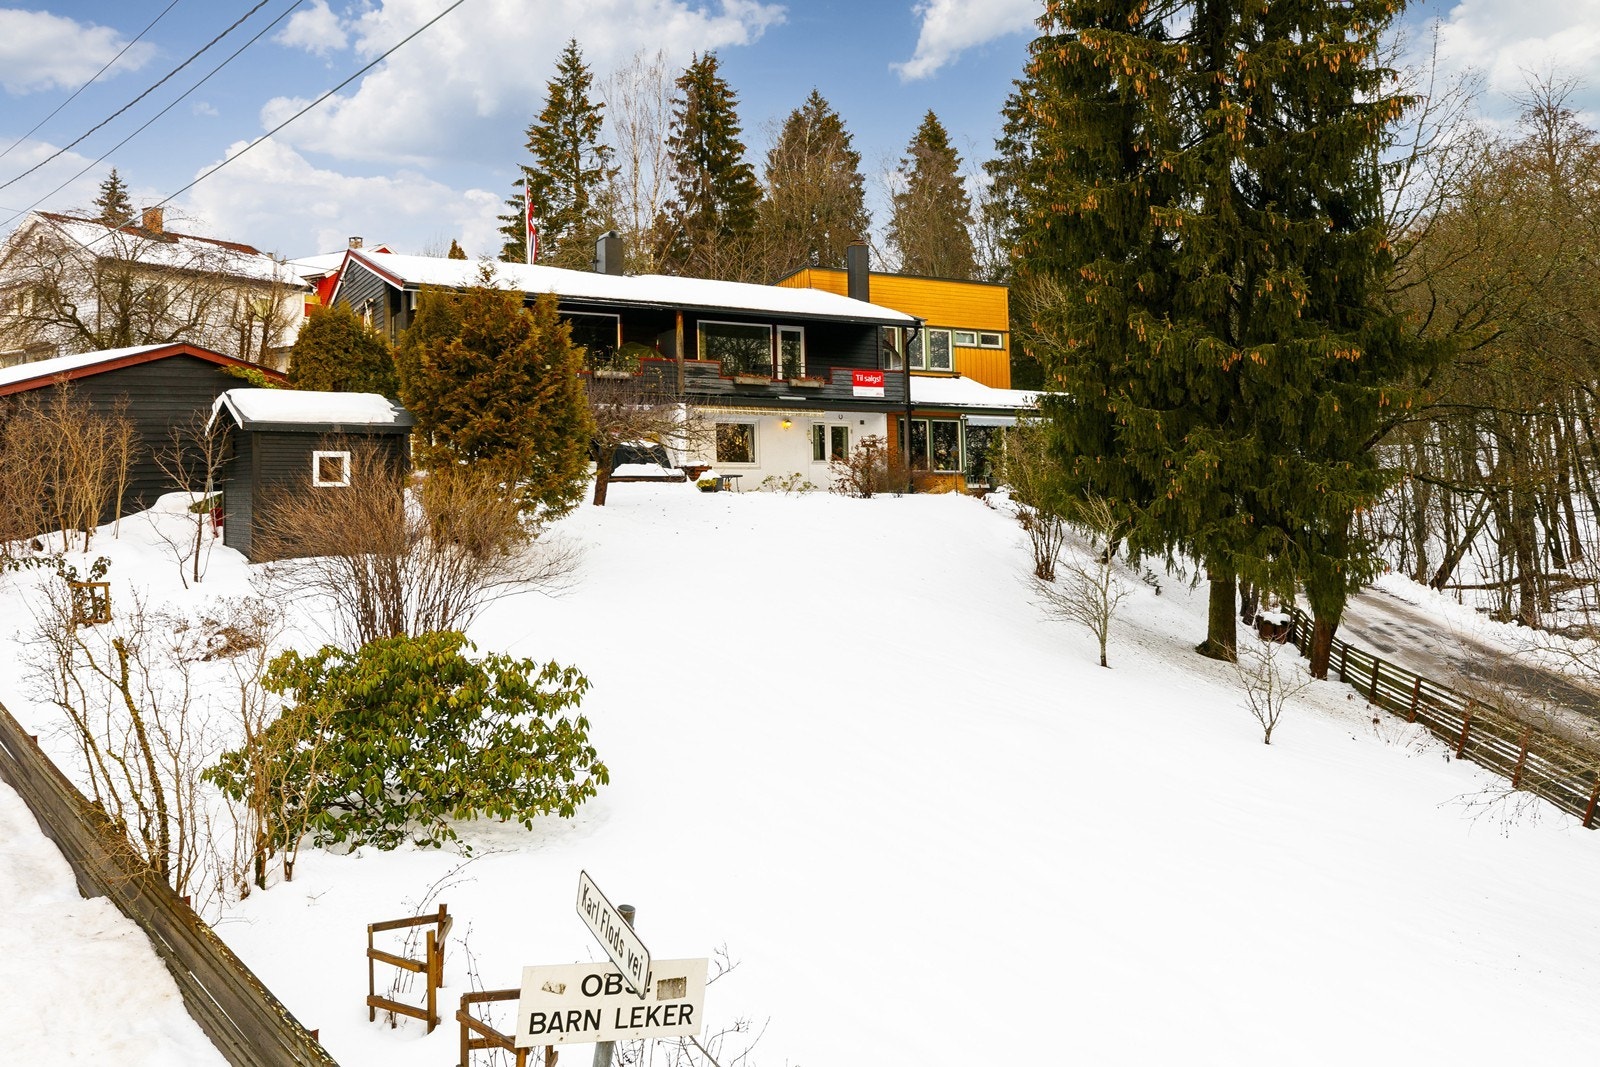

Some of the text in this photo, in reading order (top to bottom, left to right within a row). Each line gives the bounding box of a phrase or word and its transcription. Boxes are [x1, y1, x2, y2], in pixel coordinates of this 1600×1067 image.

[855, 374, 864, 382] Til
[581, 883, 644, 982] Karl Flods vei
[528, 1003, 694, 1035] BARN LEKER
